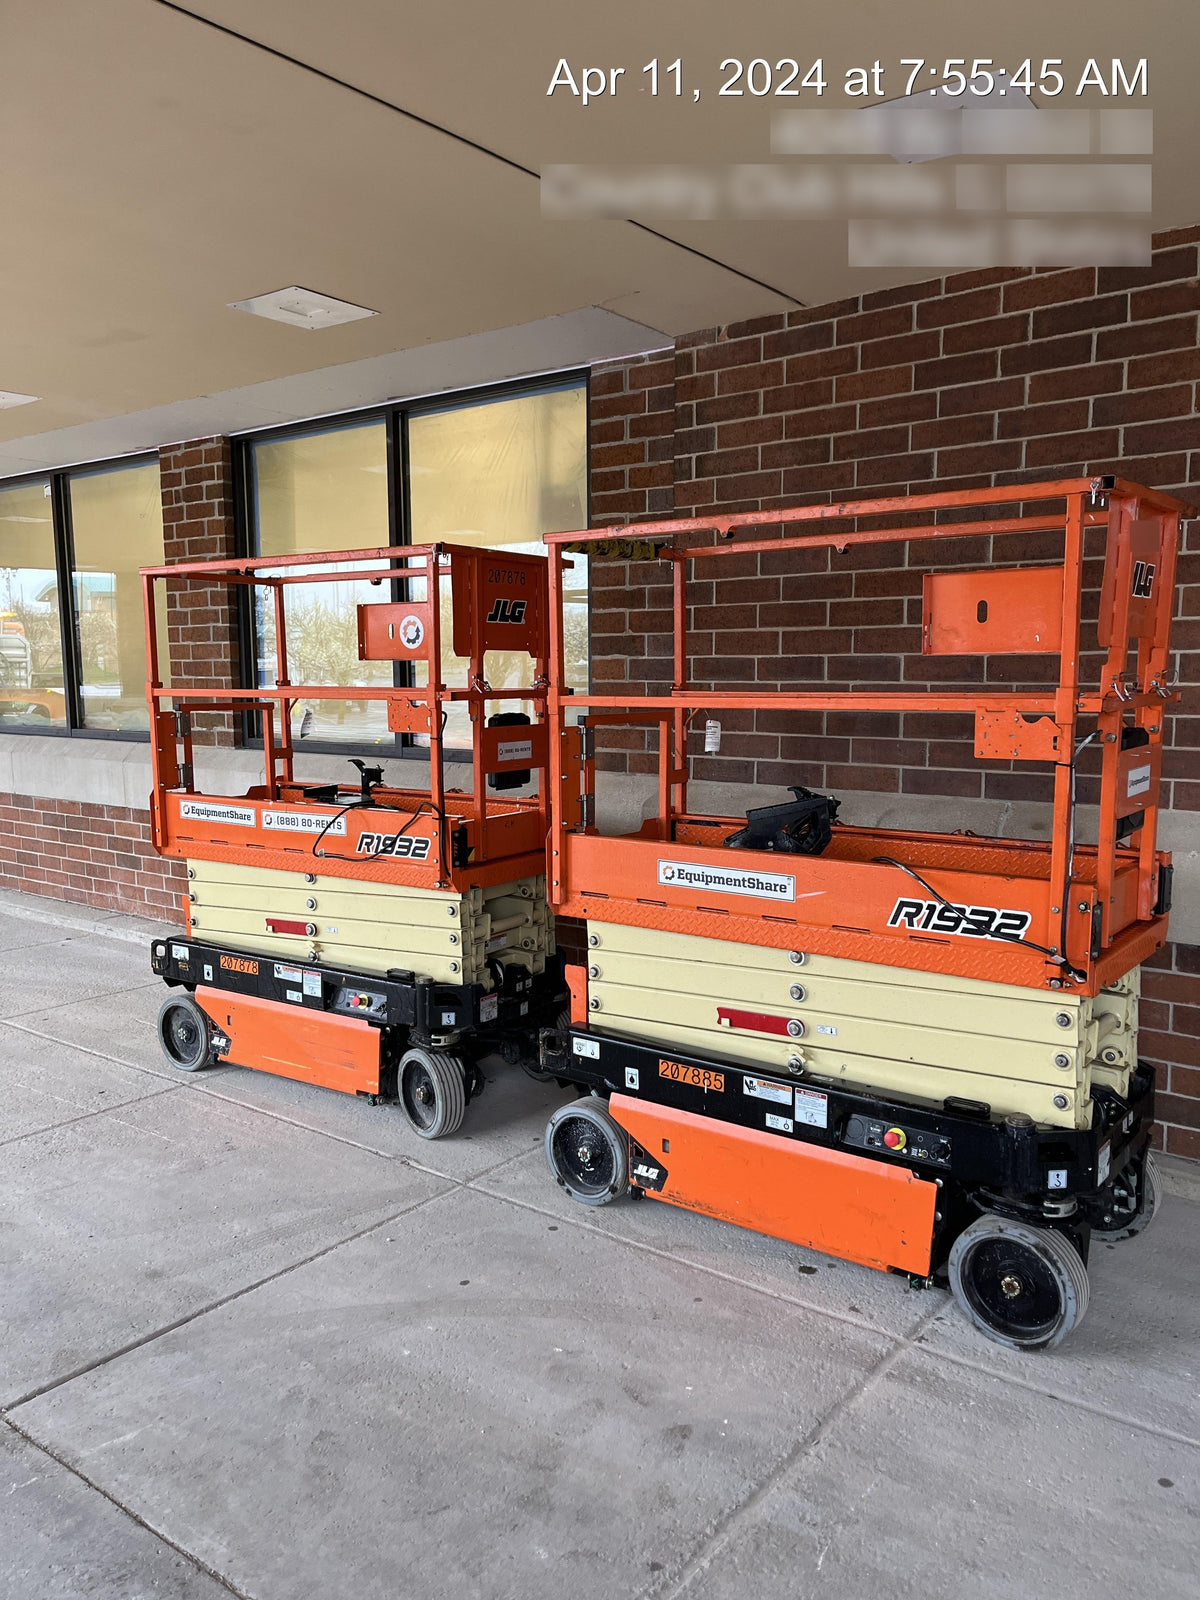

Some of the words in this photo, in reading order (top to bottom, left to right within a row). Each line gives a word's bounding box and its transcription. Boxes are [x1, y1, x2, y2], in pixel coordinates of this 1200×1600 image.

[488, 568, 526, 586] 207878
[1132, 560, 1156, 599] JLG
[486, 598, 527, 624] JLG
[190, 805, 252, 822] EquipmentShare
[276, 815, 299, 828] (888)
[356, 832, 431, 860] R1932
[676, 868, 788, 894] EquipmentShare
[888, 898, 1031, 941] R1932
[220, 956, 259, 974] 207878
[660, 1060, 723, 1091] 207885
